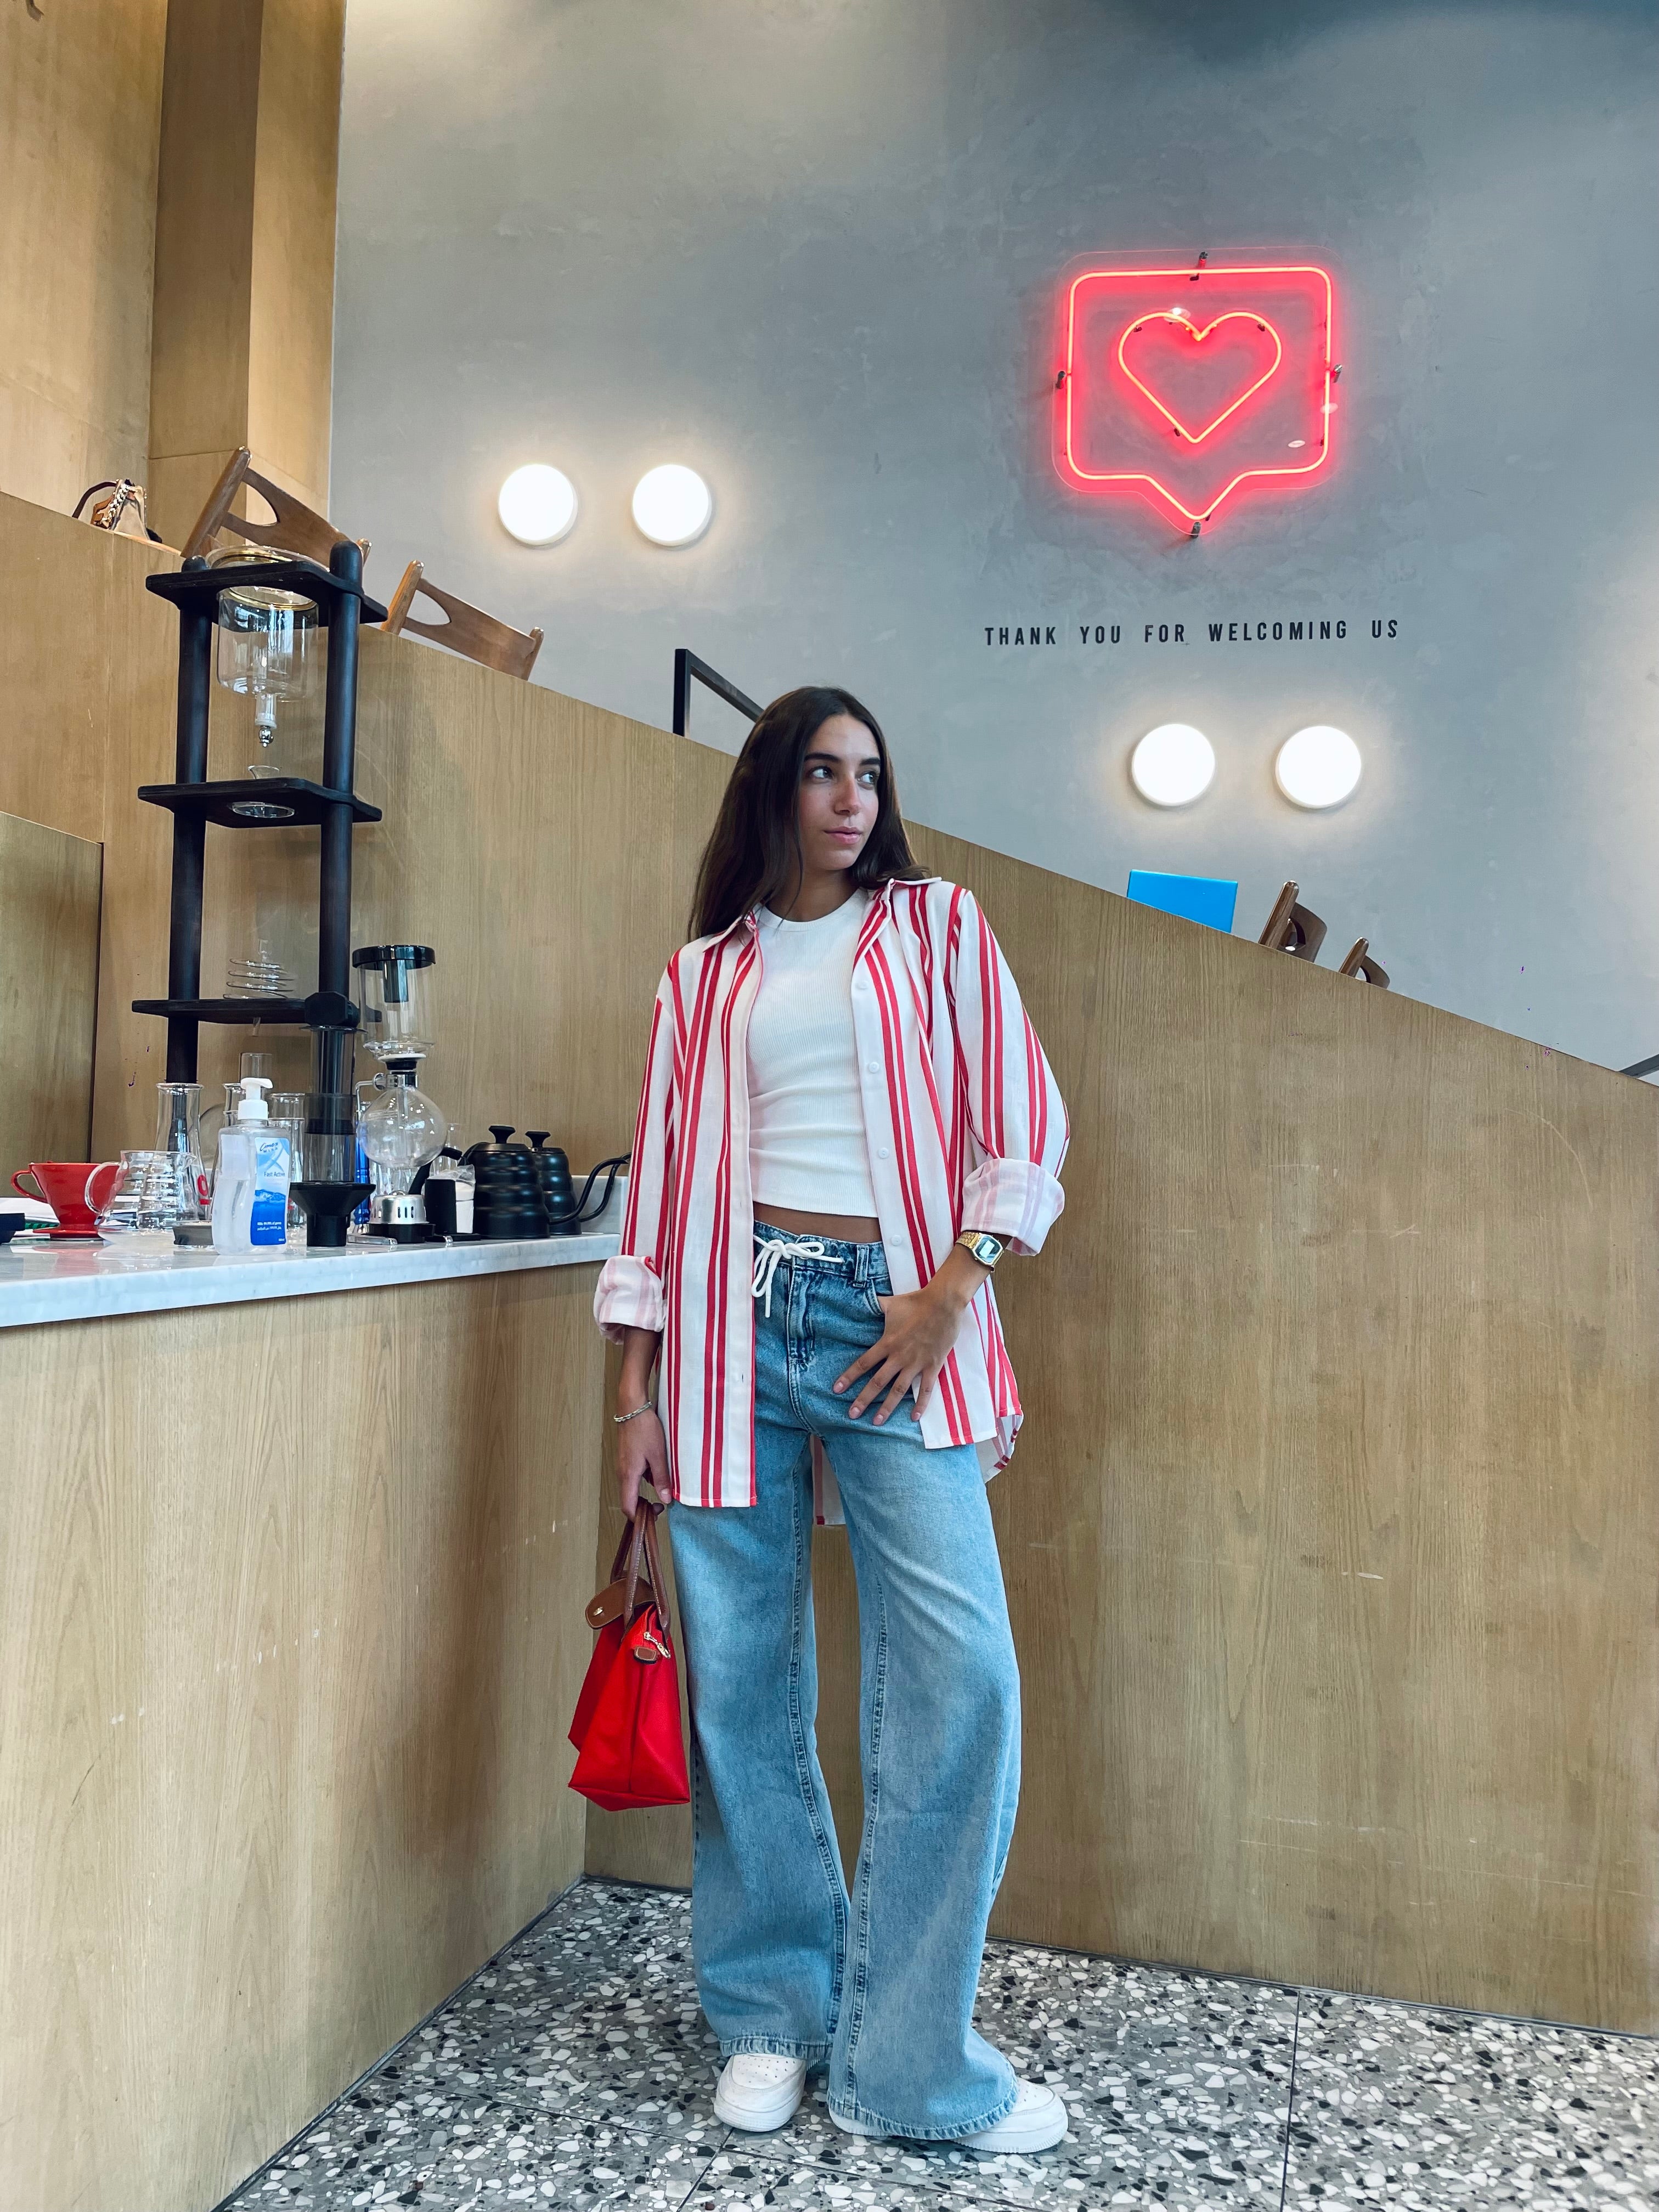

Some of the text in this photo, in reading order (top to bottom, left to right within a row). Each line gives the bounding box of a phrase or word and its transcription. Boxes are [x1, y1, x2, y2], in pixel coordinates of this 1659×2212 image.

[984, 619, 1398, 646] THANK YOU FOR WELCOMING US
